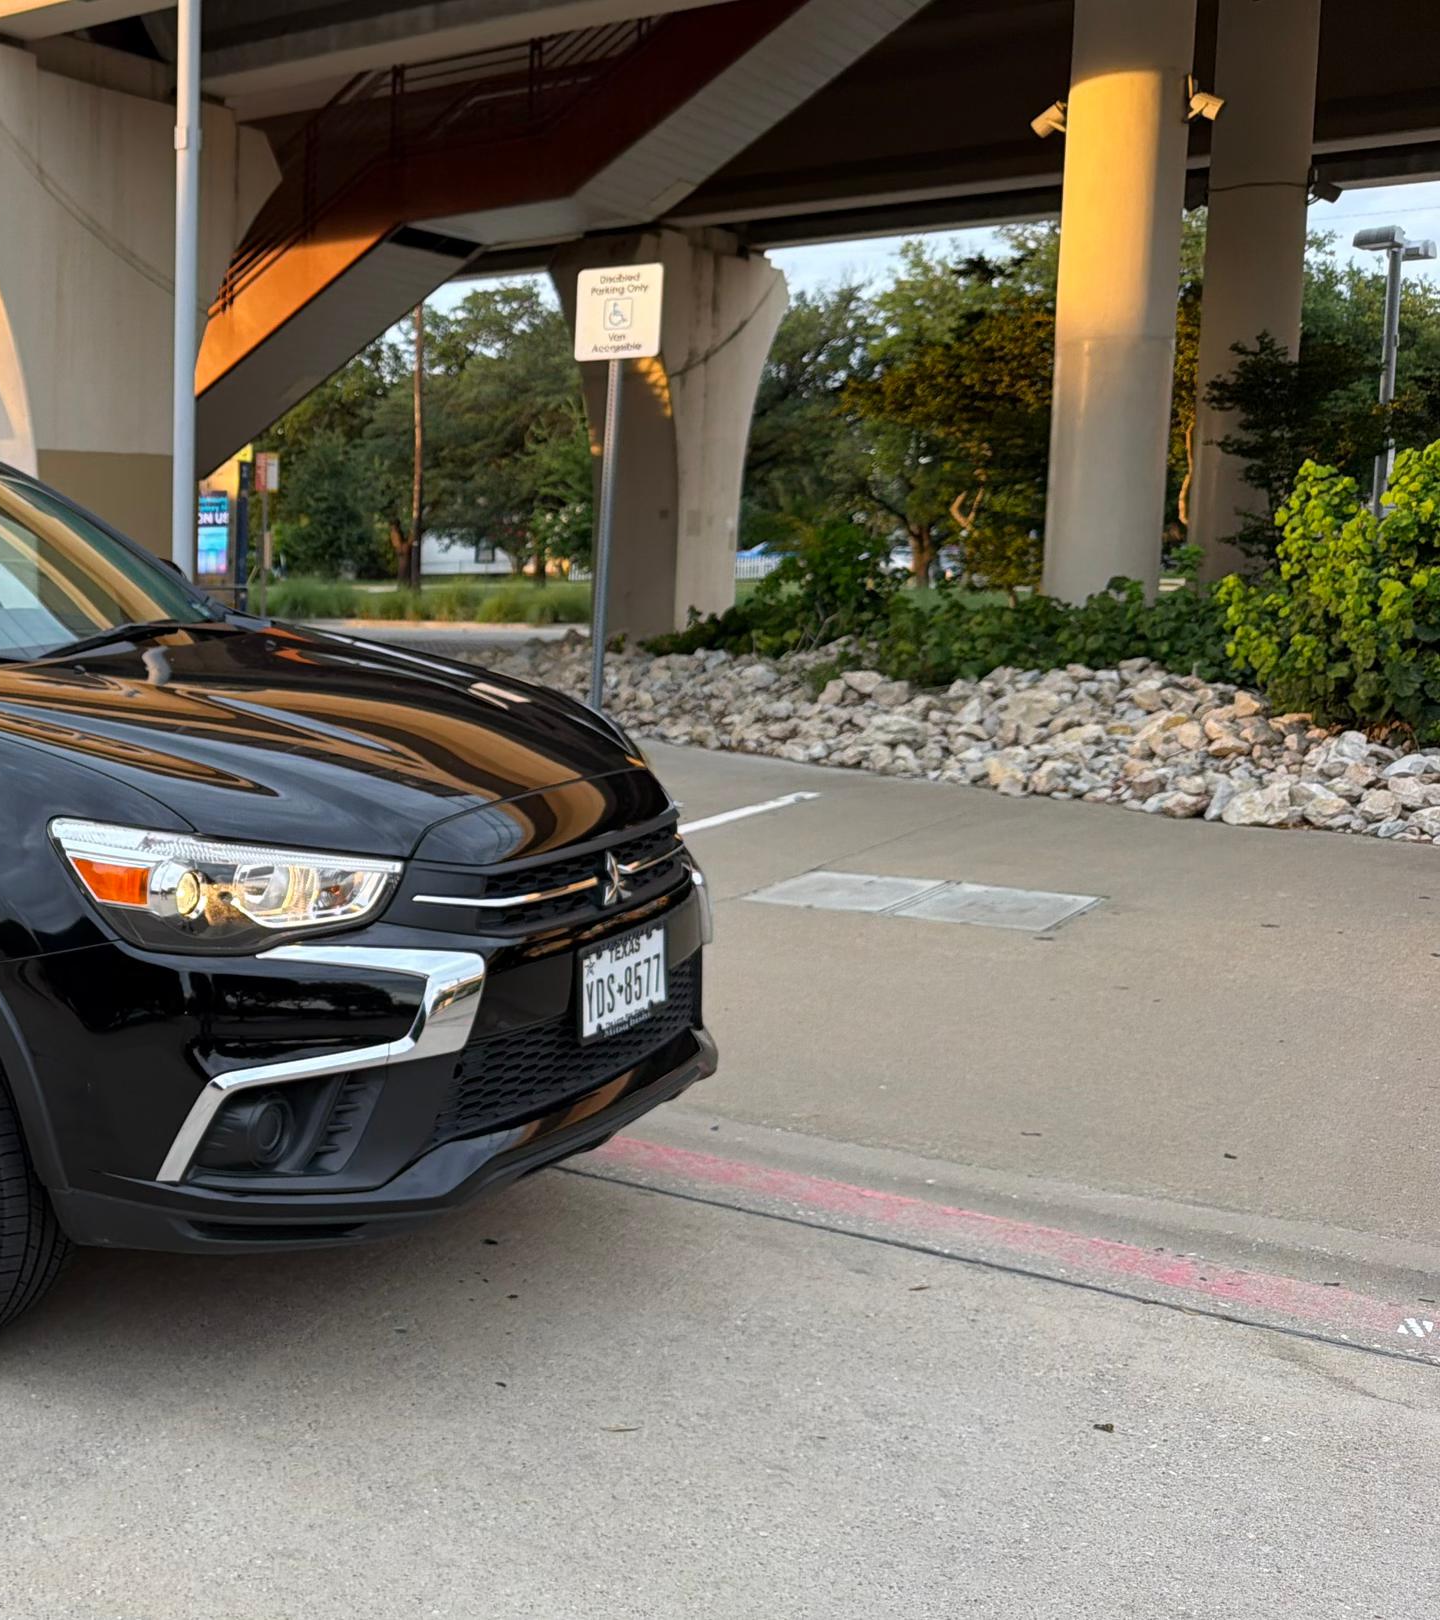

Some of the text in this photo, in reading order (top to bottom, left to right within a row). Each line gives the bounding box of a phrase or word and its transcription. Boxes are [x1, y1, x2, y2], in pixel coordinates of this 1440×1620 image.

[600, 272, 640, 284] Disabled
[591, 283, 648, 296] Parking Only
[608, 332, 626, 342] Van
[609, 935, 641, 963] TEXAS
